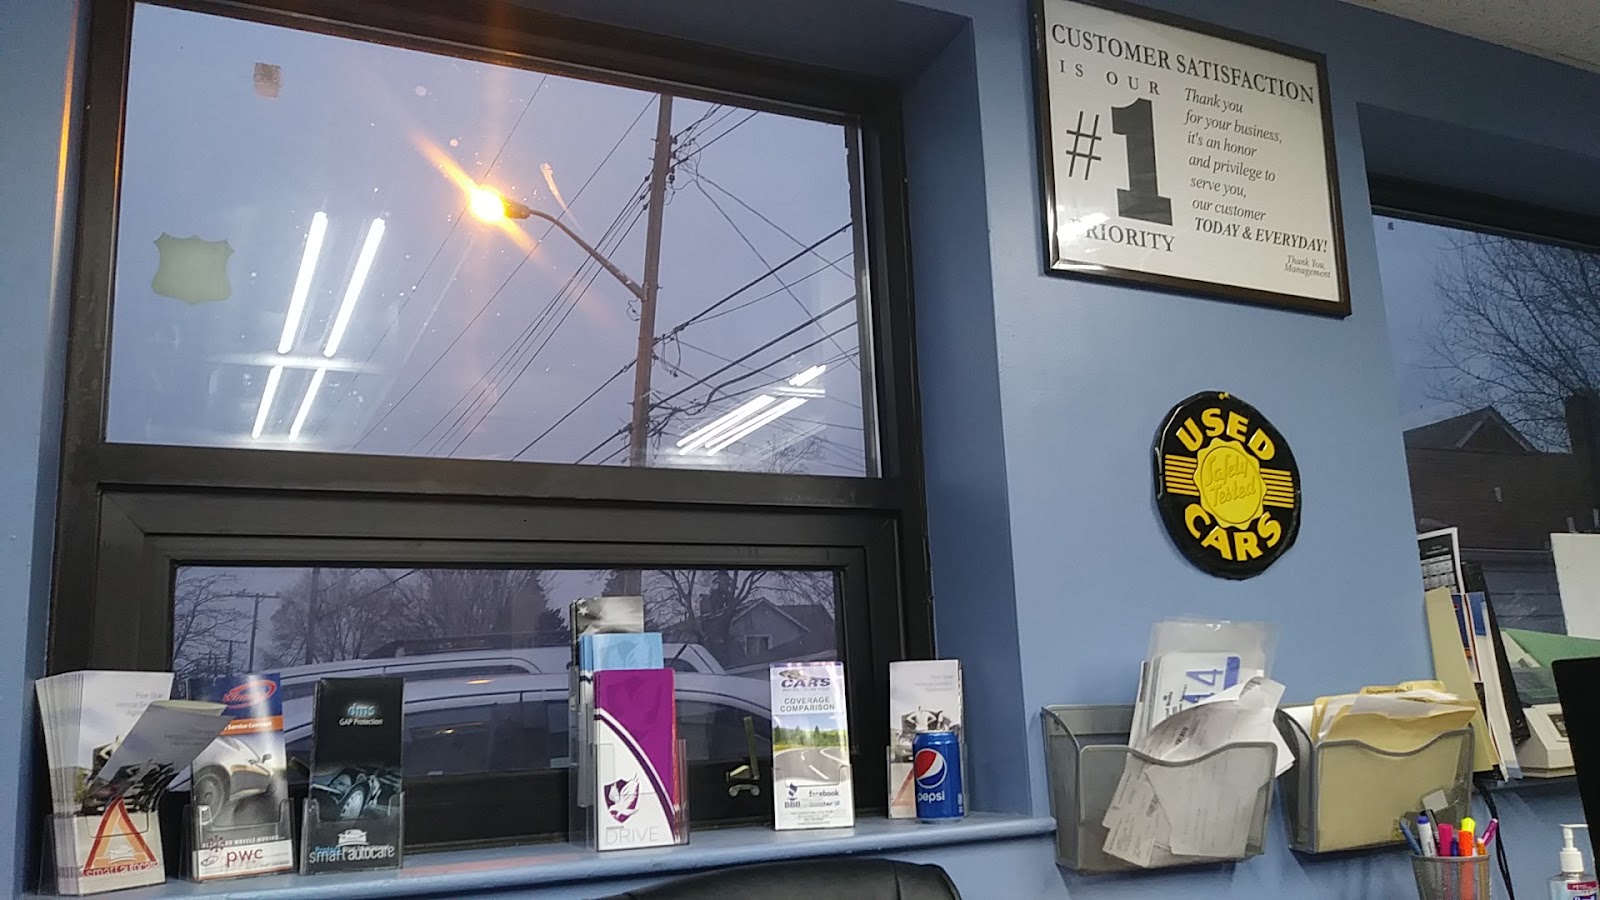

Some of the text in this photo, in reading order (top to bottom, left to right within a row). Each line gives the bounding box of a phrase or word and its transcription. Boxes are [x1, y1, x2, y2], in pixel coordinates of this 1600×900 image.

[1051, 24, 1314, 104] CUSTOMER SATISFACTION
[1060, 60, 1160, 95] IS OUR
[1185, 87, 1243, 113] Thank you
[1183, 109, 1282, 144] for your business,
[1187, 131, 1257, 156] it's an honor
[1066, 97, 1173, 226] #1
[1188, 155, 1276, 182] and privilege to
[1190, 177, 1247, 198] serve you,
[1192, 199, 1266, 221] our customer
[1076, 222, 1175, 252] RIORITY
[1194, 216, 1328, 253] TODAY & EVERYDAY!
[1284, 263, 1331, 278] Management
[1287, 254, 1309, 267] Thank
[1175, 408, 1275, 460] USED
[1205, 454, 1248, 487] Safety
[1210, 475, 1256, 507] Tested
[1184, 503, 1281, 561] CARS
[781, 677, 831, 688] CARS
[780, 704, 835, 712] COMPARISON
[784, 696, 831, 705] COVERAGE
[339, 718, 384, 726] GAP Protection
[917, 789, 946, 803] pepsi
[605, 826, 660, 845] DRIVE
[226, 848, 264, 868] pwc
